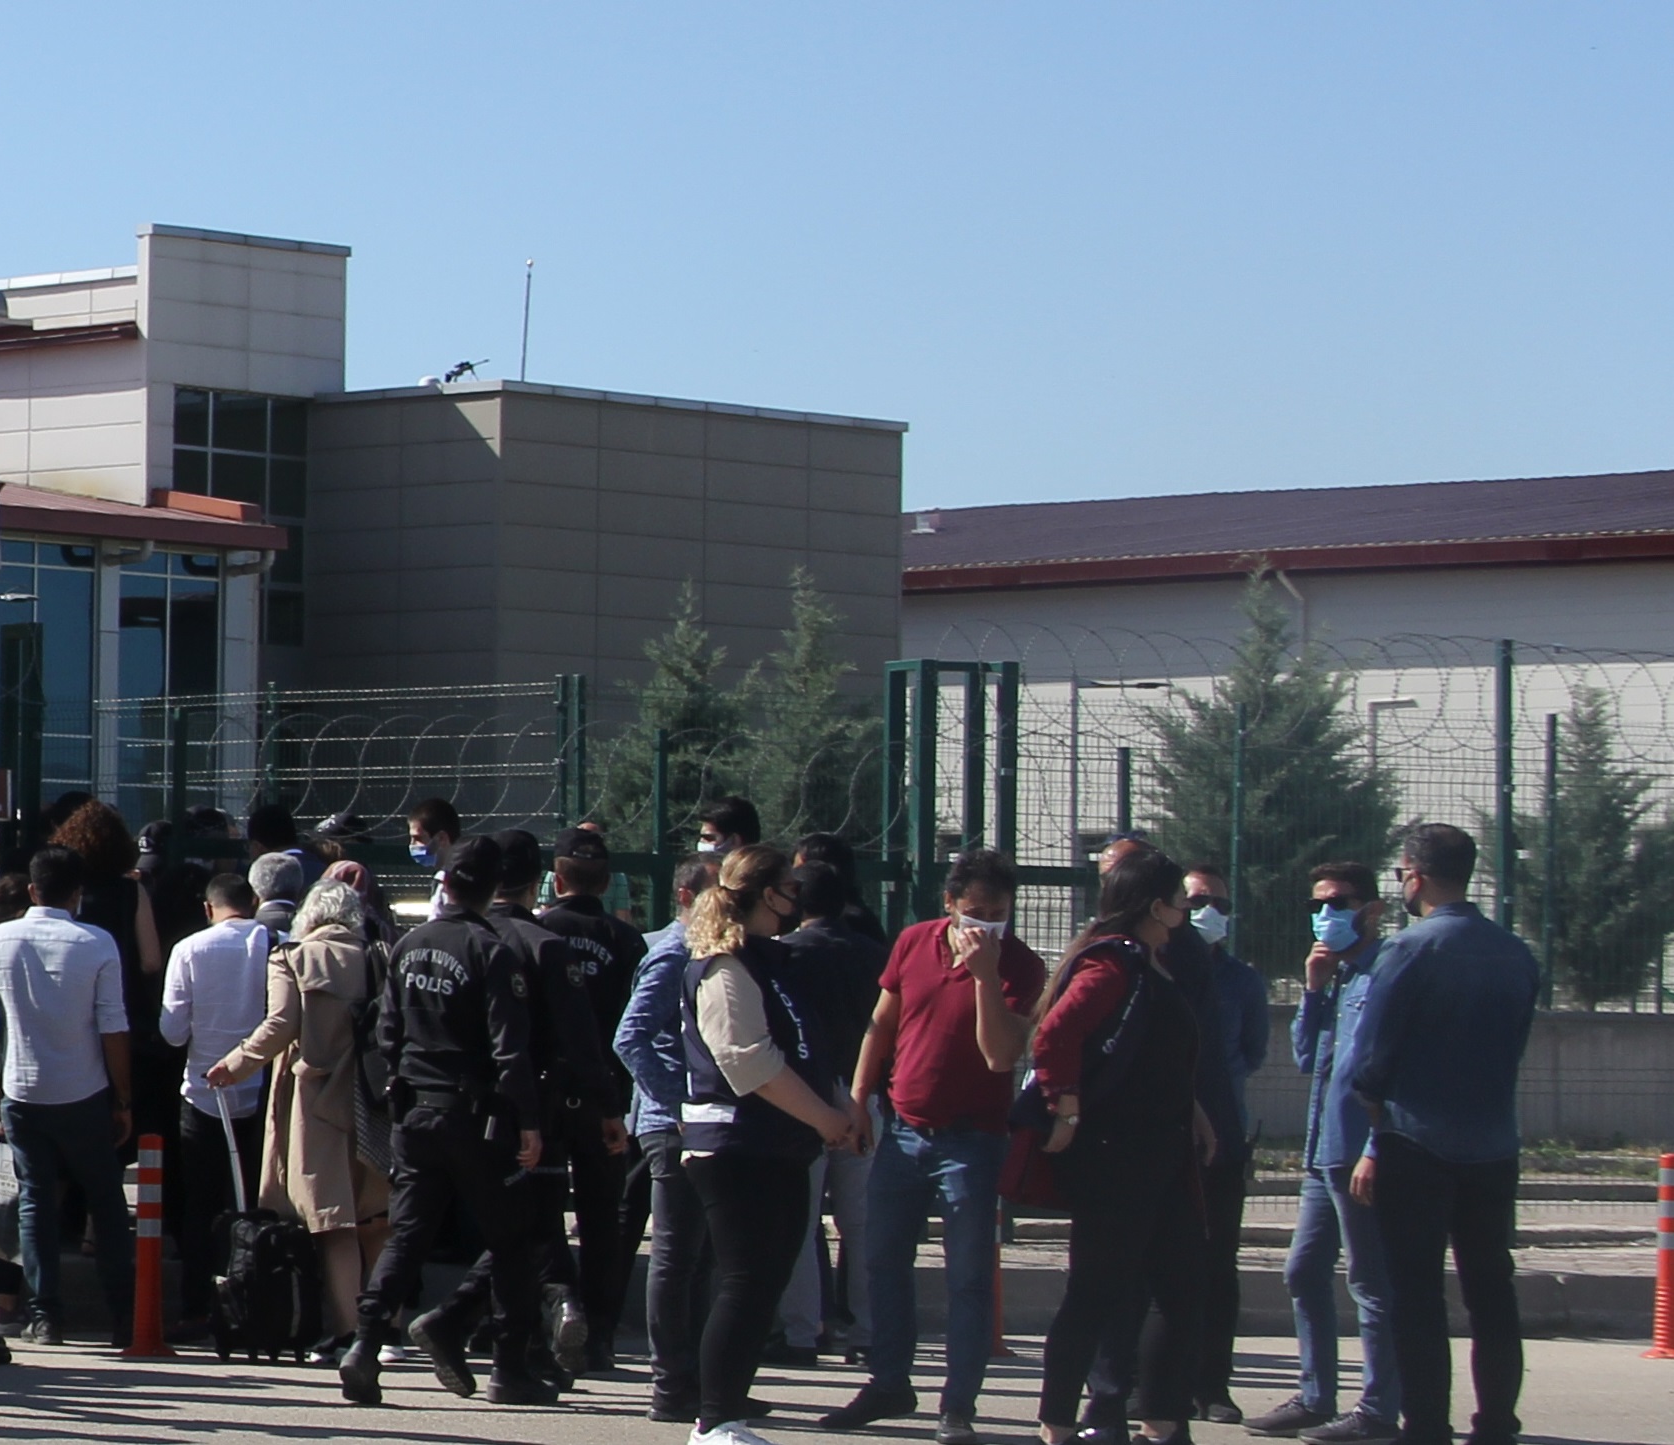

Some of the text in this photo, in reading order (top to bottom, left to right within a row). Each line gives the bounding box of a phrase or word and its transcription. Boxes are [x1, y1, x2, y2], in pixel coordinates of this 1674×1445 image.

[569, 935, 613, 966] KUVVET
[431, 948, 470, 987] KUVVET
[405, 972, 454, 996] POLİS
